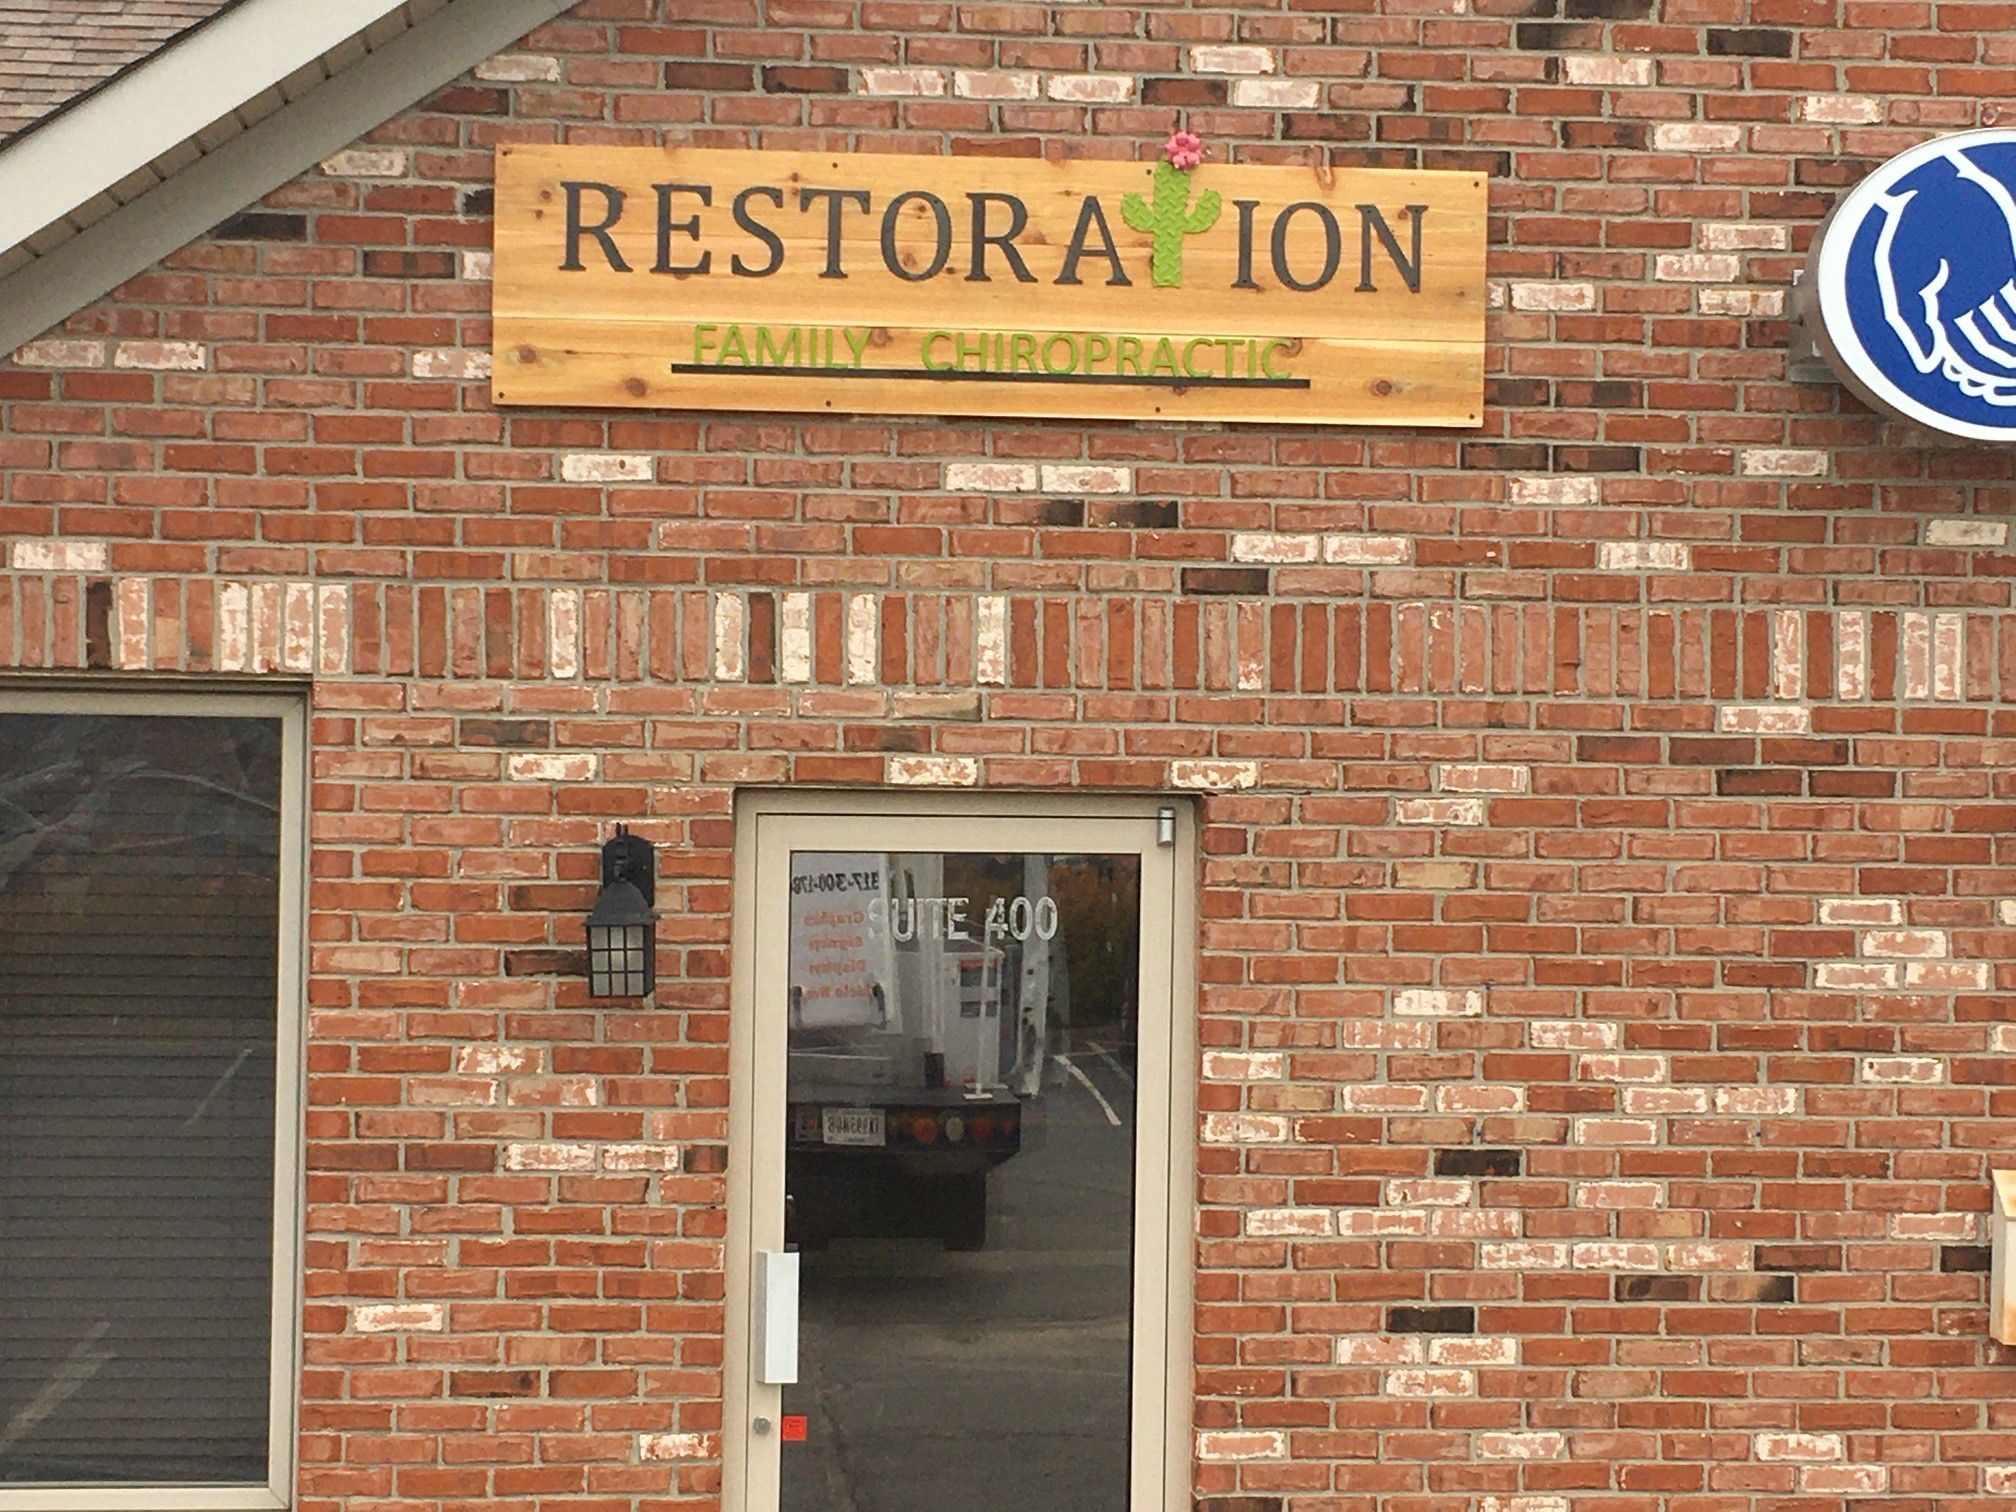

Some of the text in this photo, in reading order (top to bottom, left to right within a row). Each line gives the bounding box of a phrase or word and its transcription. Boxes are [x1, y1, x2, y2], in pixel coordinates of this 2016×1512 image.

[558, 181, 1429, 293] RESTORAION
[693, 323, 1293, 379] FAMILY CHIROPRACTIC
[867, 896, 1059, 942] SUITE 400
